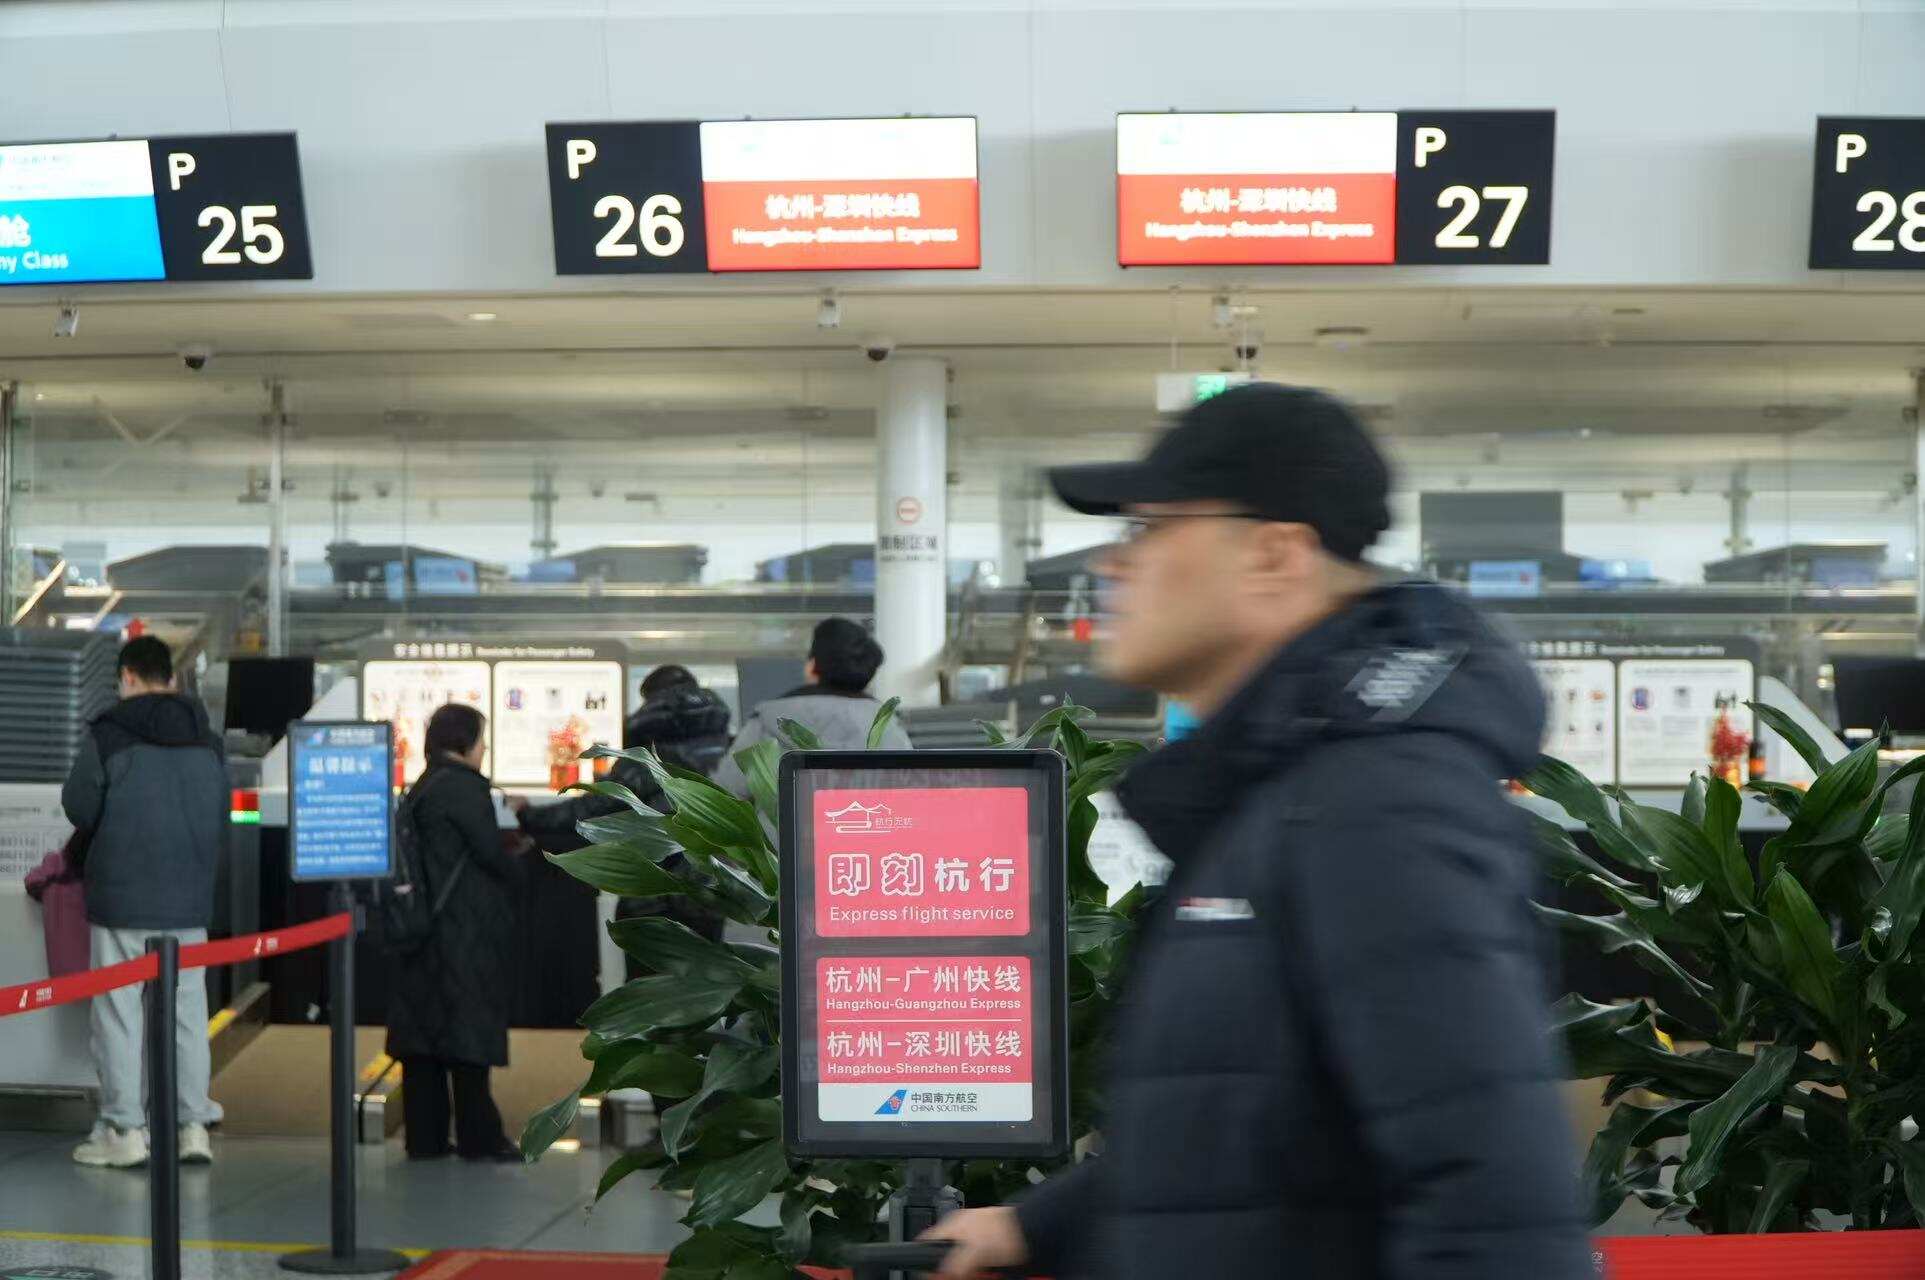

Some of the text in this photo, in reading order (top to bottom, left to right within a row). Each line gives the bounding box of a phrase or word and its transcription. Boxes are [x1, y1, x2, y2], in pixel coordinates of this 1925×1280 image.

[566, 140, 597, 180] P
[1415, 128, 1447, 168] P
[1836, 134, 1867, 174] P
[167, 152, 196, 191] P
[197, 205, 285, 265] 25
[593, 194, 685, 258] 26
[1434, 186, 1529, 249] 27
[1853, 190, 1925, 253] 28
[22, 250, 69, 270] Class
[828, 852, 1016, 897] 即刻杭行
[830, 904, 1016, 924] Express flight service
[825, 965, 1022, 993] 杭州-广州快线
[826, 998, 1022, 1012] Hangzhou-Guangzhou Express
[827, 1030, 1023, 1058] 杭州-深圳快线
[827, 1062, 1012, 1076] Hangzhou-Shenzhen Express
[910, 1092, 978, 1104] 中国南方航空
[910, 1104, 978, 1113] CHINA SOUTHERN
